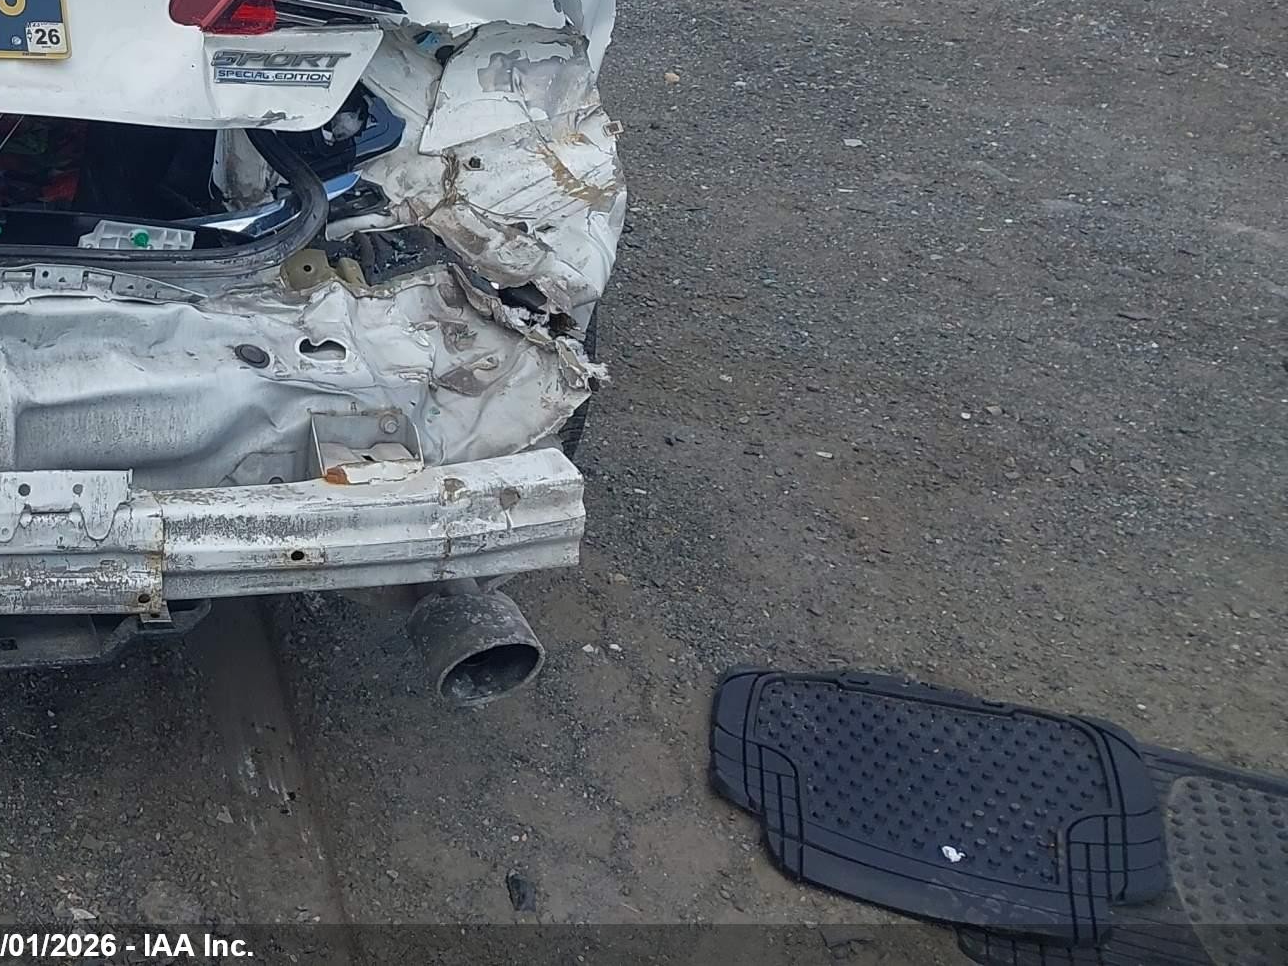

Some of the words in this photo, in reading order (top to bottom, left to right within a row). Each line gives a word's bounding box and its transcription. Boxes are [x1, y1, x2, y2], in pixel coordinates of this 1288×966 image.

[34, 28, 61, 45] 26
[211, 50, 352, 68] SPORT
[218, 68, 269, 80] SPECIAL
[274, 72, 331, 81] EDITION
